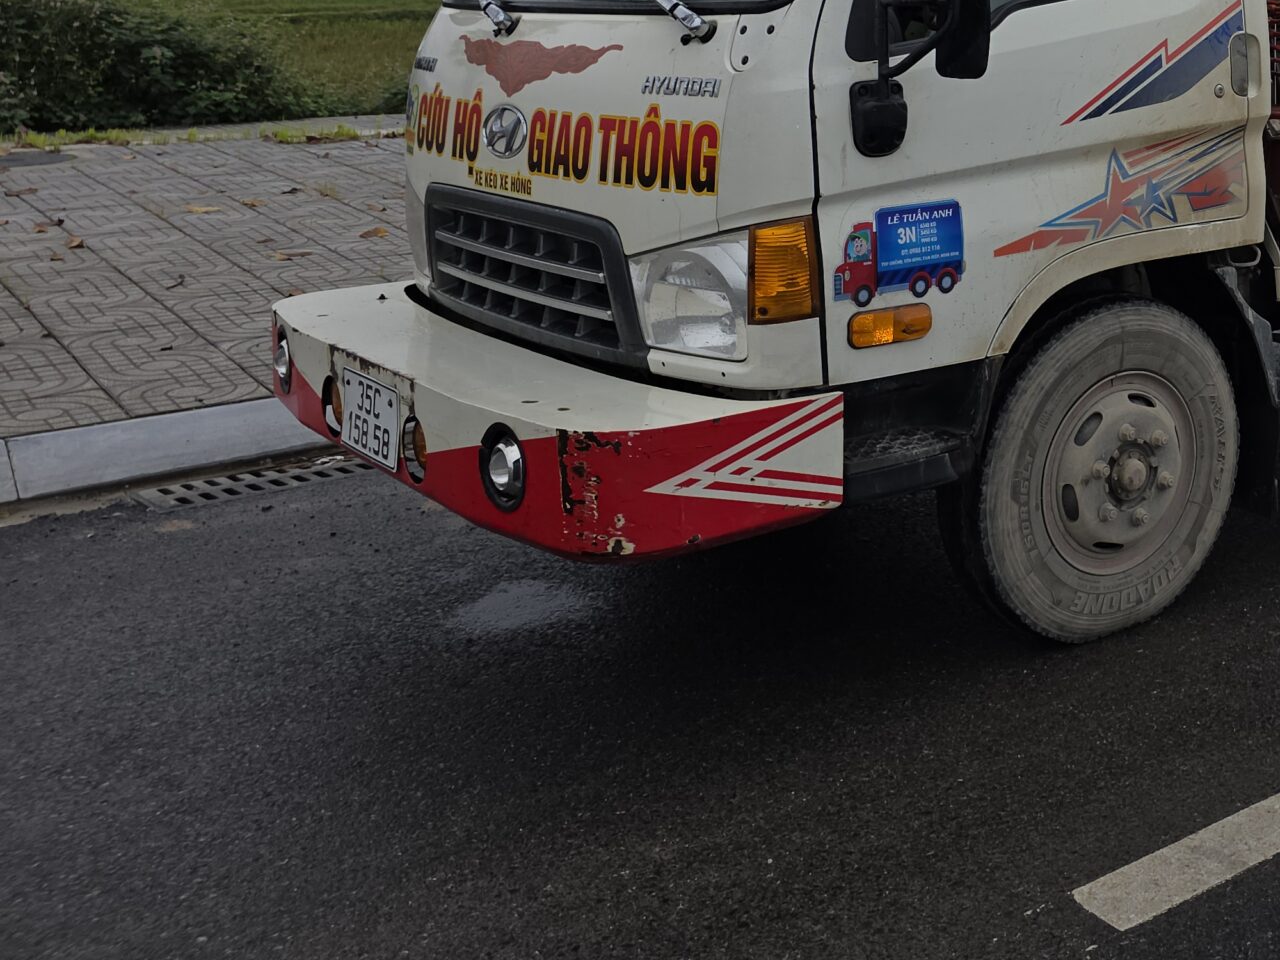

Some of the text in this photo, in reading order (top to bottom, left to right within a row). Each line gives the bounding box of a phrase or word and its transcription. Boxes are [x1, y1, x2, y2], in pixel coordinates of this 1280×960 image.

[642, 75, 722, 98] HYUNDAI
[417, 82, 451, 157] CỨU
[451, 88, 483, 179] HỘ
[527, 107, 593, 184] GIAO
[597, 103, 721, 197] THÔNG
[474, 169, 483, 187] XE
[500, 172, 509, 191] XE
[888, 214, 900, 225] LÊ
[931, 208, 953, 219] ANH
[897, 226, 917, 245] 3N
[357, 380, 382, 419] 35C
[349, 411, 391, 461] 158.58
[1070, 556, 1183, 616] ROADONE
